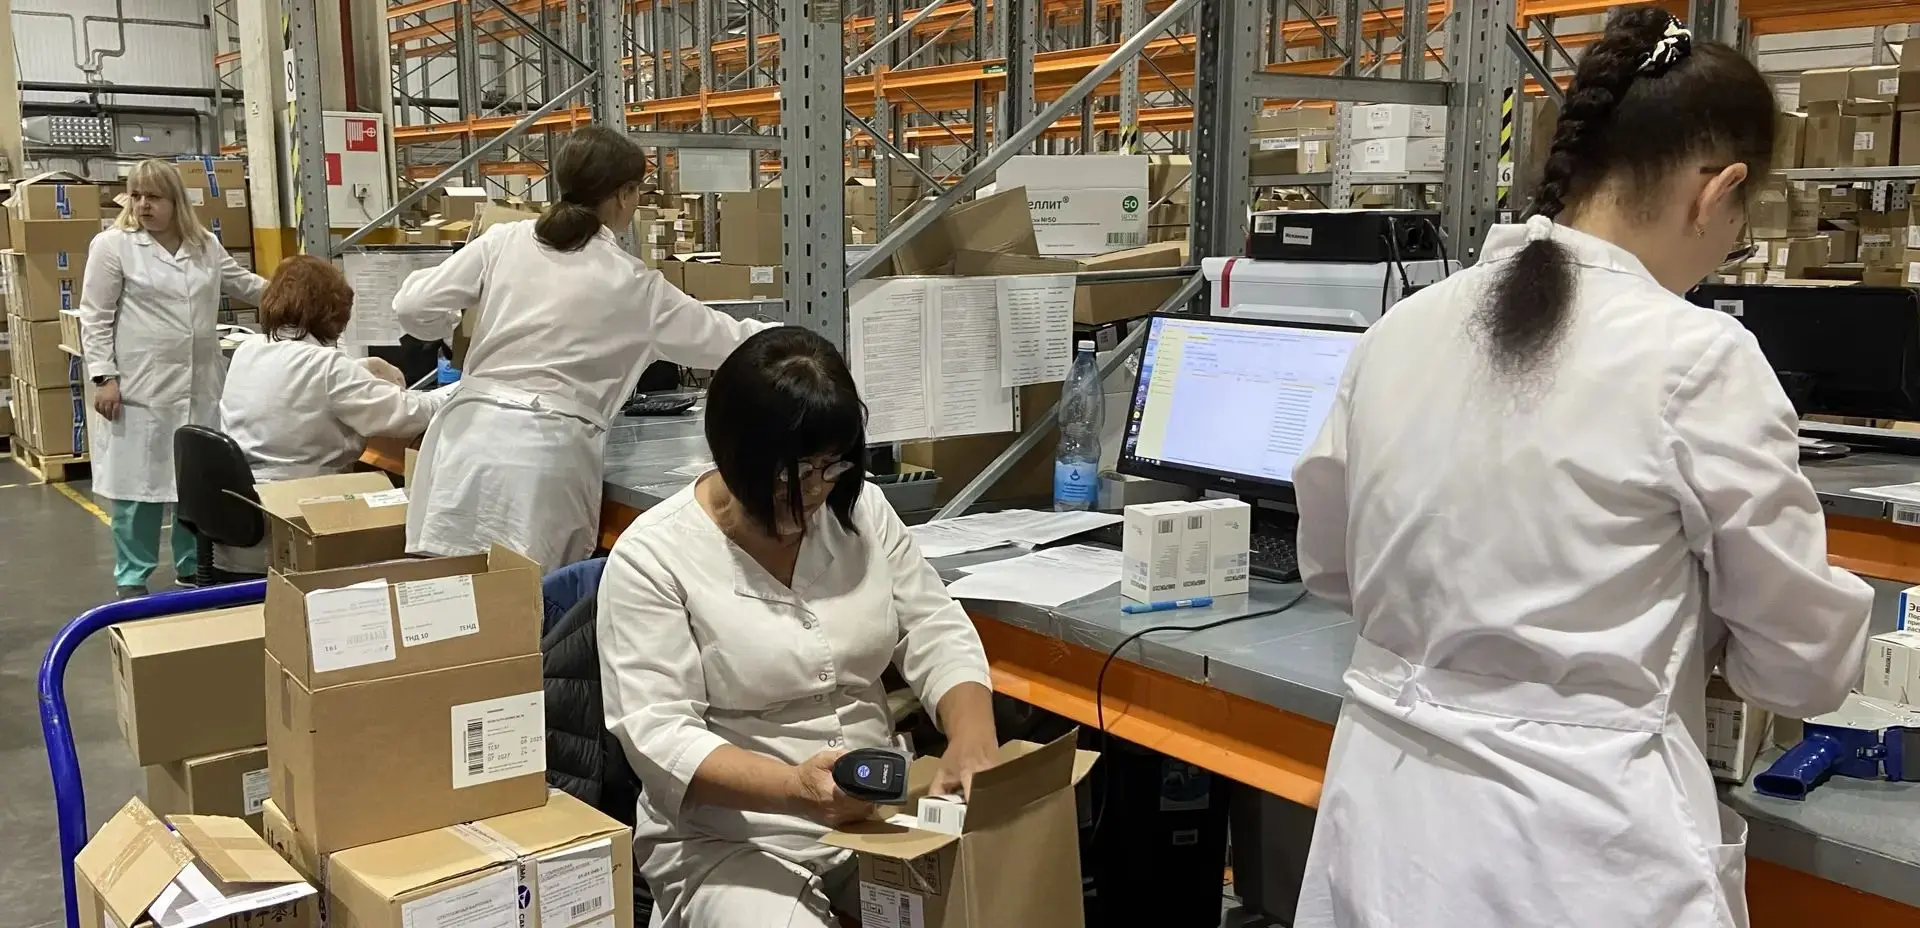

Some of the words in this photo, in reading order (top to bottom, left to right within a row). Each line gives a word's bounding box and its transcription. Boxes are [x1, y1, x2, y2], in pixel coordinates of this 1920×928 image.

[287, 61, 294, 92] 8
[1502, 168, 1511, 182] 6
[1124, 200, 1137, 209] 50
